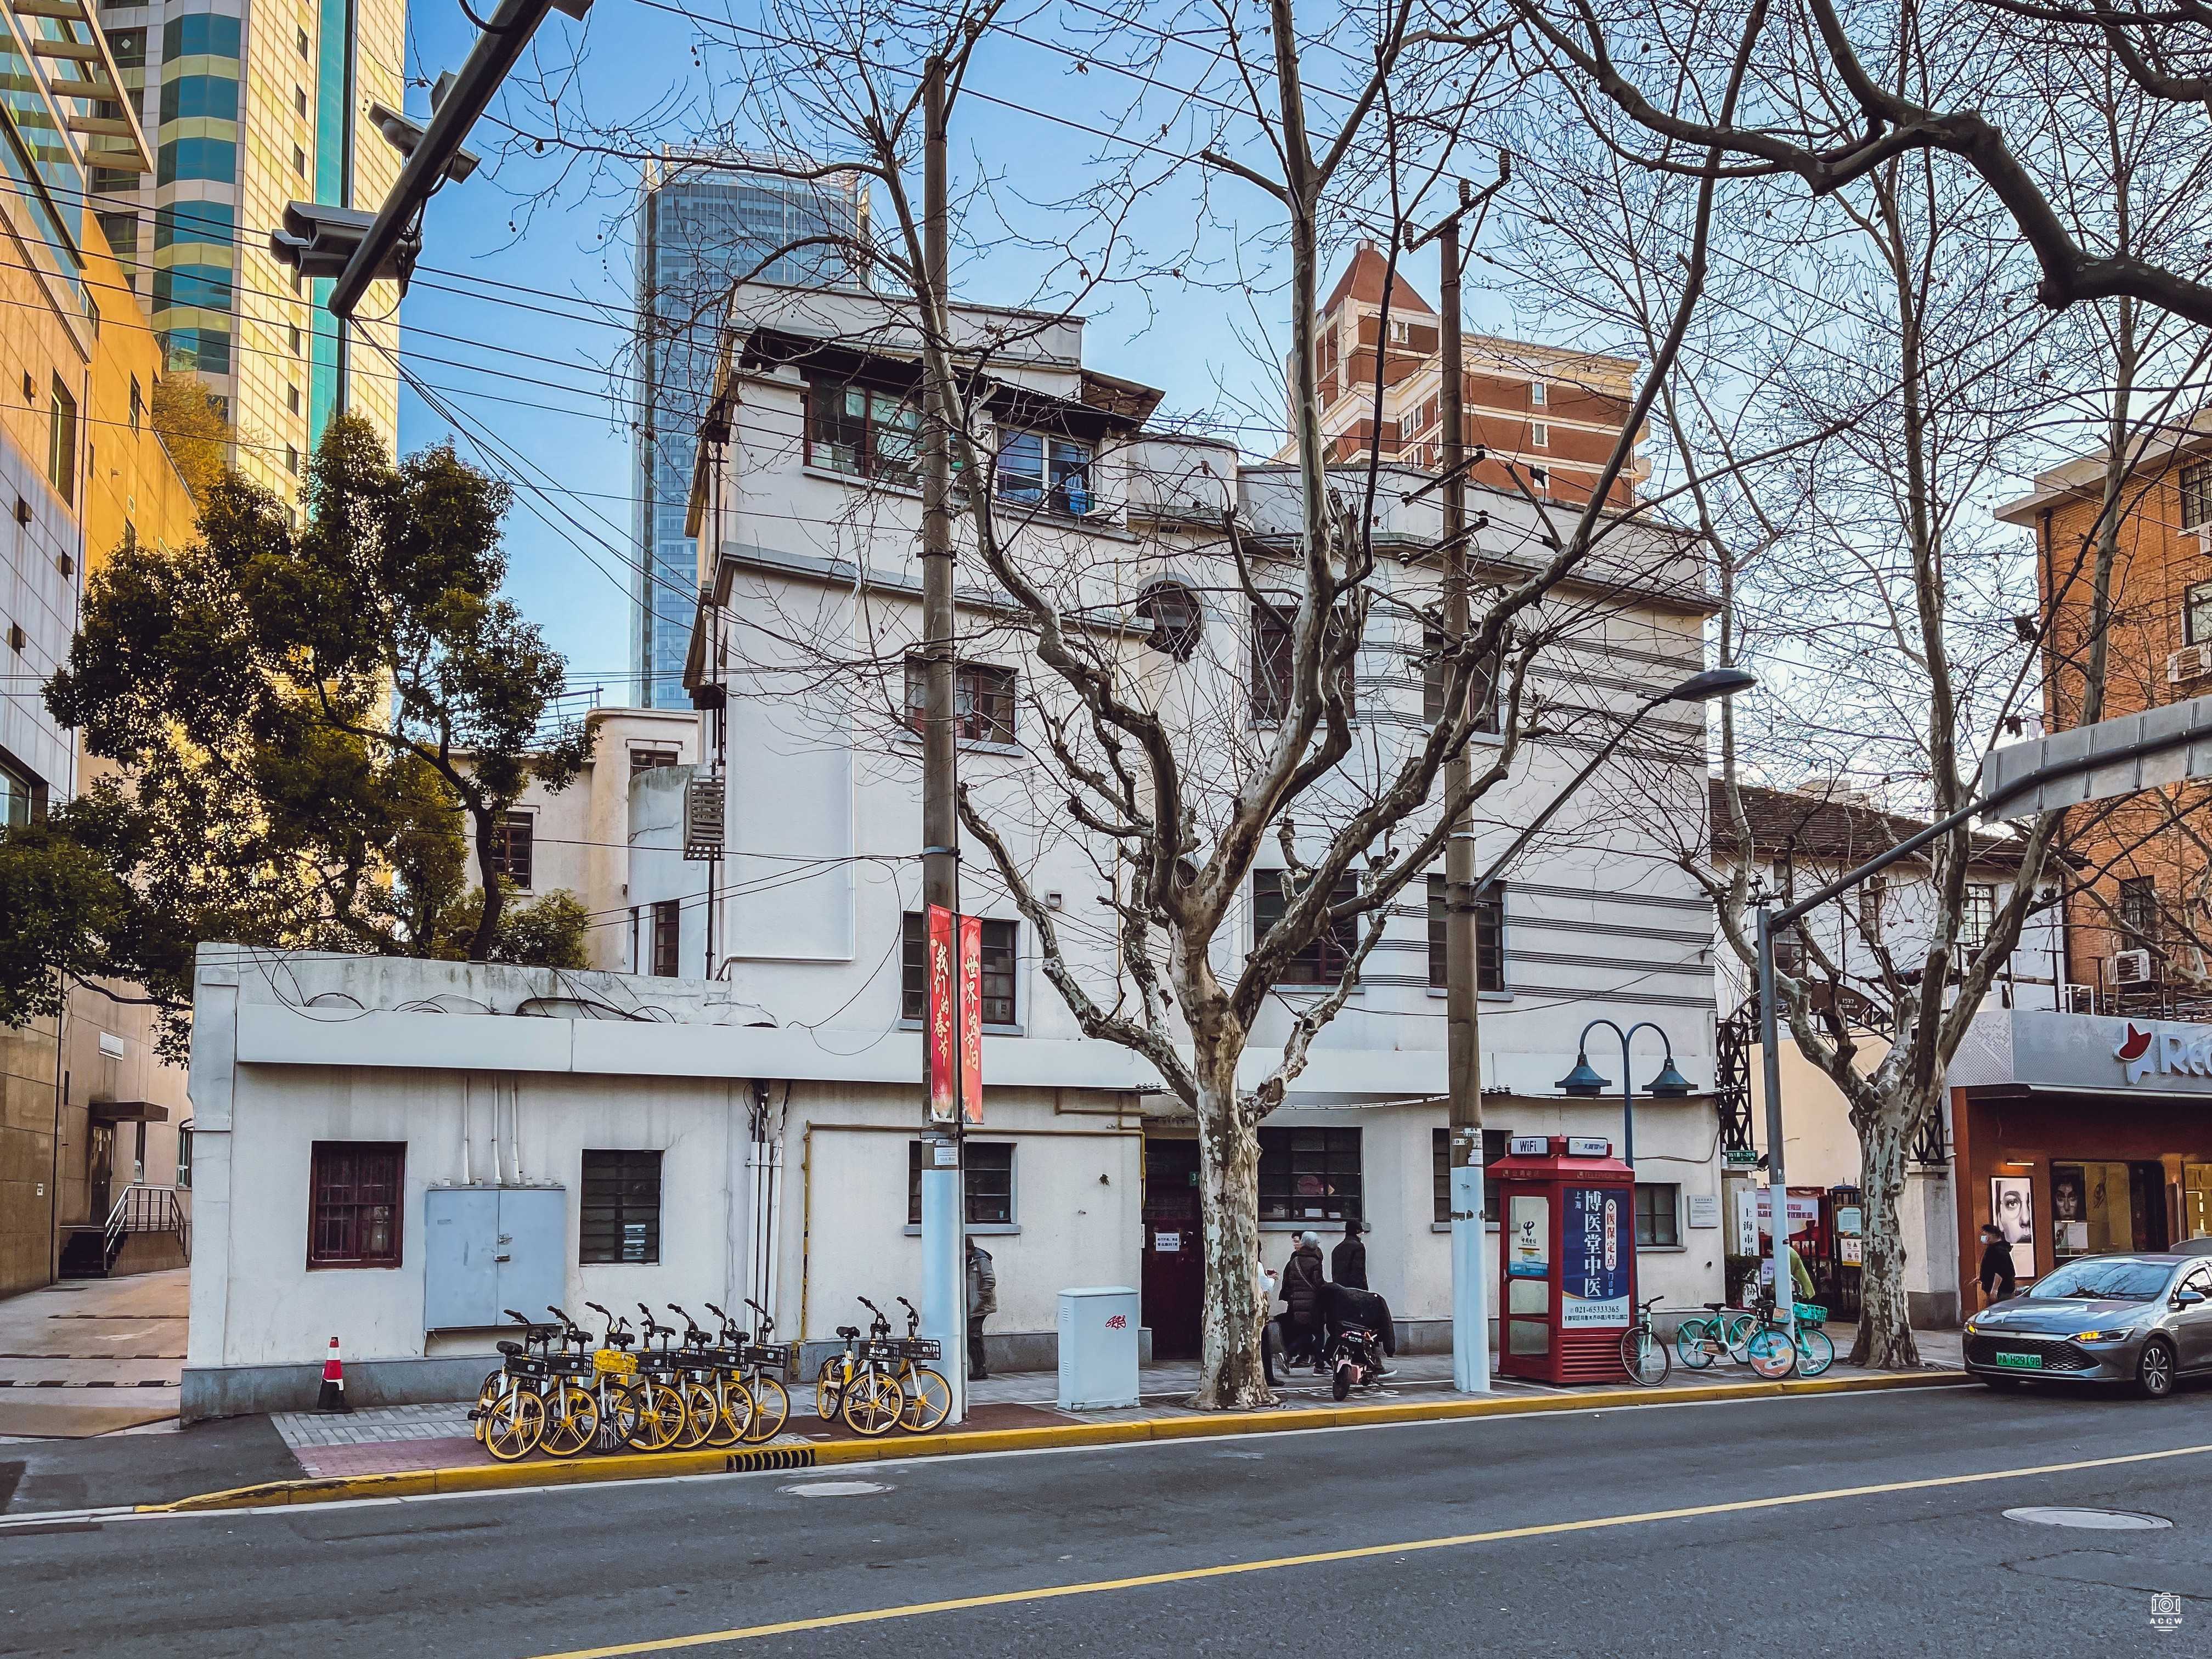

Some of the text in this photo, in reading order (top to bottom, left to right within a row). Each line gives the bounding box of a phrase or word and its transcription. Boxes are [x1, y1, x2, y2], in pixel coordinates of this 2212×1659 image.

[934, 941, 950, 1068] 我们的春节
[964, 953, 980, 1071] 世界的节日
[1520, 1141, 1537, 1152] WiFi
[1575, 1191, 1582, 1209] 上海
[1606, 1213, 1615, 1267] 医保定点
[1584, 1190, 1602, 1298] 博医堂中医
